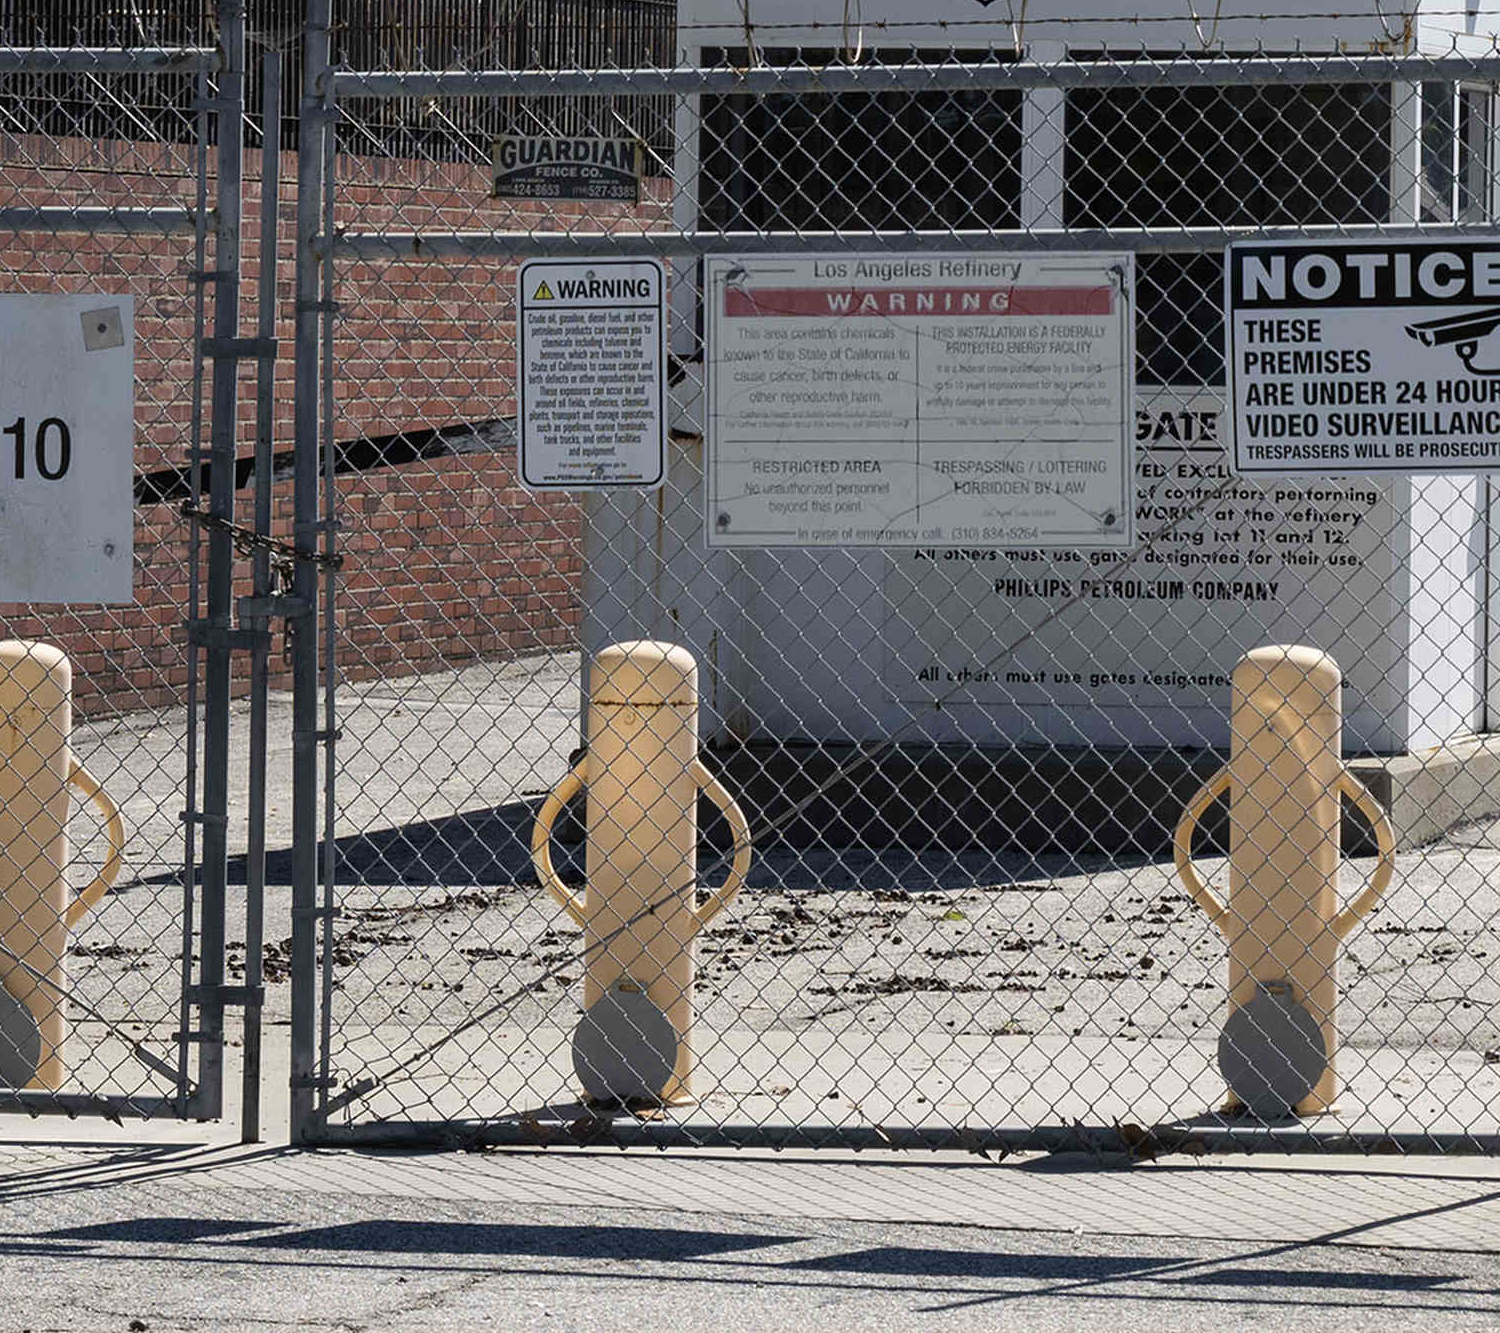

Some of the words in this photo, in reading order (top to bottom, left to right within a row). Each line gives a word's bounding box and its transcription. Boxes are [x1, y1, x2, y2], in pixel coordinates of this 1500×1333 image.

[500, 140, 635, 172] GUARDIAN
[536, 167, 577, 177] FENCE
[580, 167, 603, 178] CO.
[814, 262, 847, 278] Los
[855, 262, 932, 280] Angeles
[940, 261, 1022, 281] Refinery
[558, 280, 650, 299] WARNING
[828, 293, 1012, 311] WARNING
[1243, 319, 1321, 343] THESE
[1244, 349, 1371, 374] PREMISES
[1245, 382, 1294, 406] ARE
[1302, 381, 1386, 405] UNDER
[1395, 381, 1427, 404] 24
[1245, 413, 1318, 437] VIDEO
[2, 416, 71, 480] 10
[1246, 443, 1349, 459] TRESPASSERS
[1354, 443, 1390, 458] WILL
[1395, 442, 1414, 457] BE
[753, 461, 840, 474] RESTRICTED
[844, 461, 881, 474] AREA
[995, 579, 1072, 598] PHILLIPS
[1081, 580, 1184, 599] PETROLEUM
[1193, 581, 1278, 600] COMPANY
